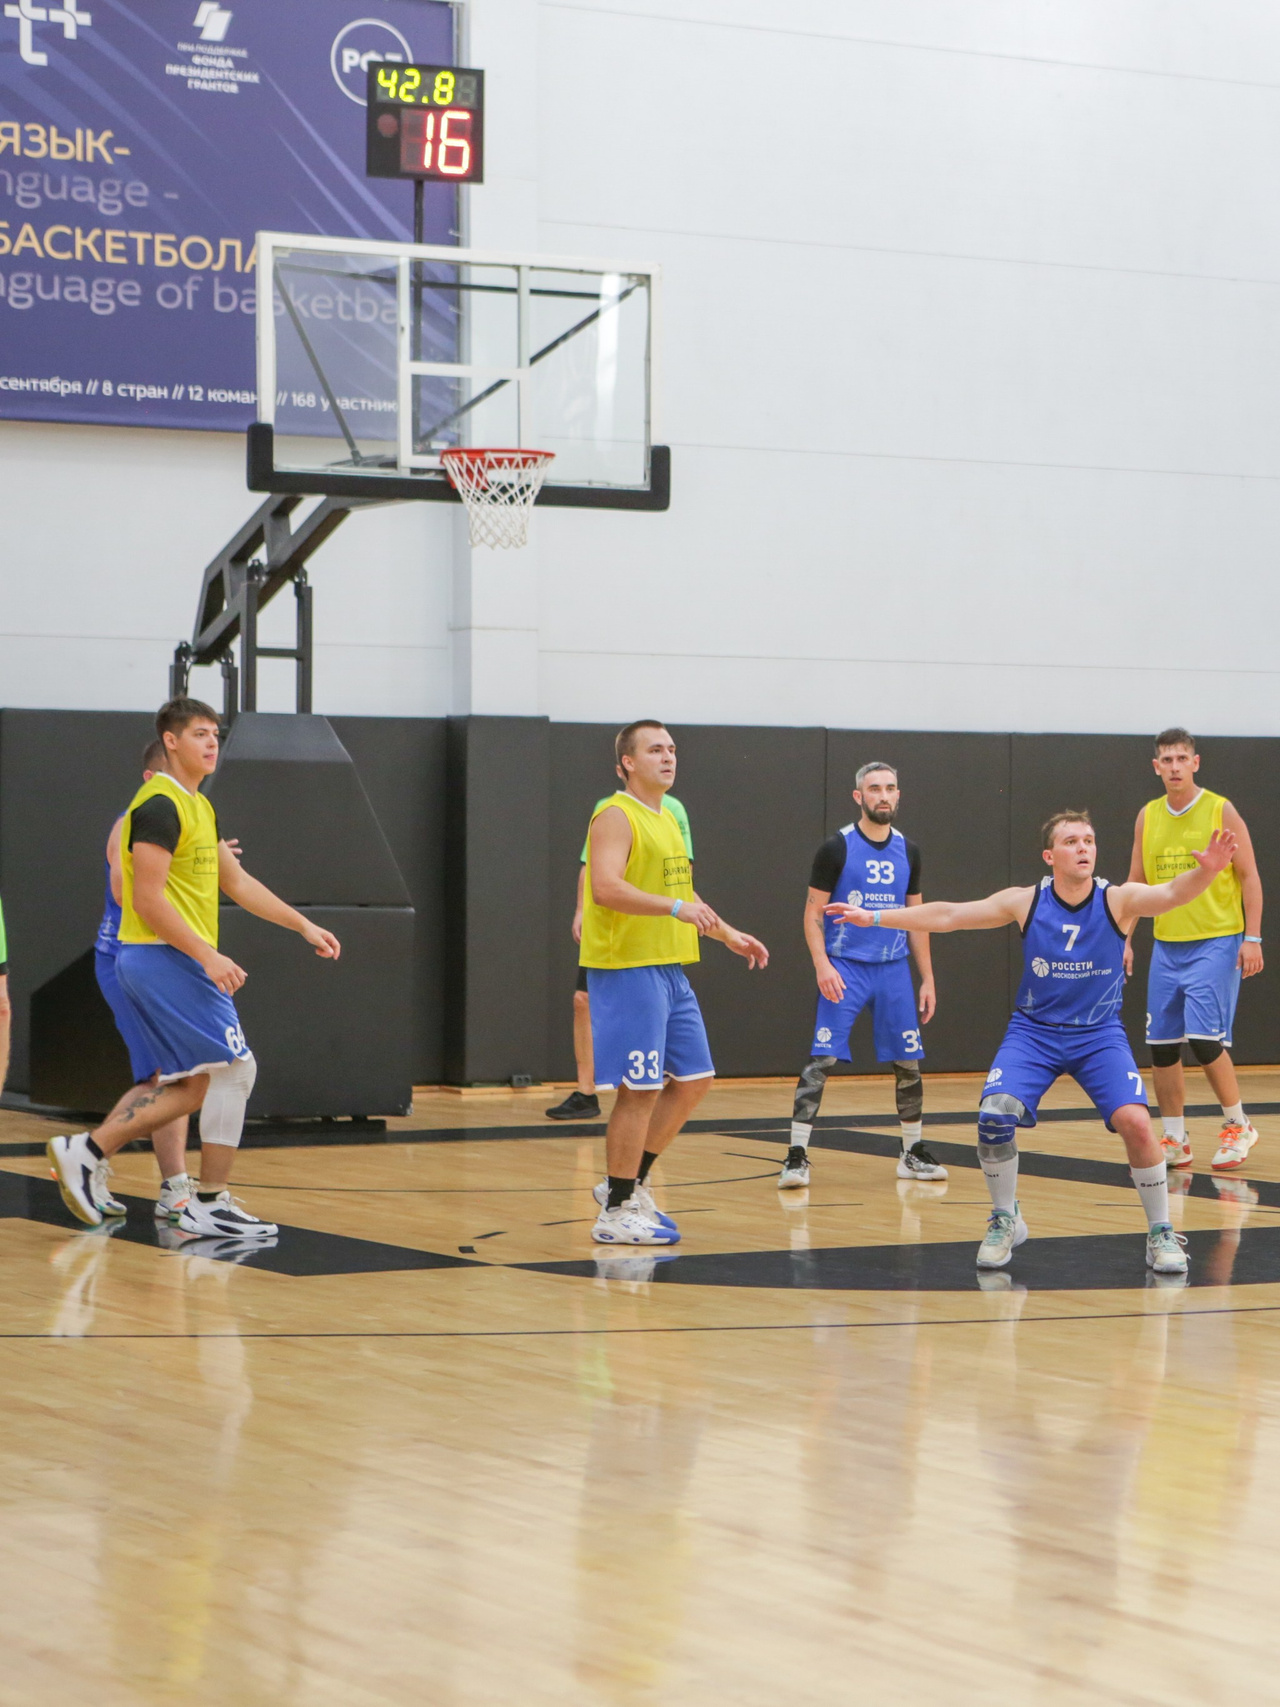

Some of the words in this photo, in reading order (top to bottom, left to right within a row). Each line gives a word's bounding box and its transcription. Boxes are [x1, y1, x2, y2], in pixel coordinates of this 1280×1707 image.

[165, 63, 260, 84] ПРЕЗИДЕНТСКИХ
[192, 54, 235, 69] ФОНДА
[187, 78, 239, 94] ГРАНТОВ
[377, 68, 455, 105] 42.8
[423, 110, 471, 175] 16
[155, 275, 204, 310] of
[0, 376, 82, 397] сентября
[102, 380, 113, 396] 8
[117, 383, 168, 401] стран
[188, 385, 204, 401] 12
[292, 390, 316, 408] 168
[865, 860, 895, 884] 33
[1062, 924, 1081, 951] 7
[1051, 961, 1093, 971] РОССЕТИ
[902, 1028, 923, 1053] 3
[628, 1050, 659, 1080] 33
[1127, 1071, 1142, 1096] 7
